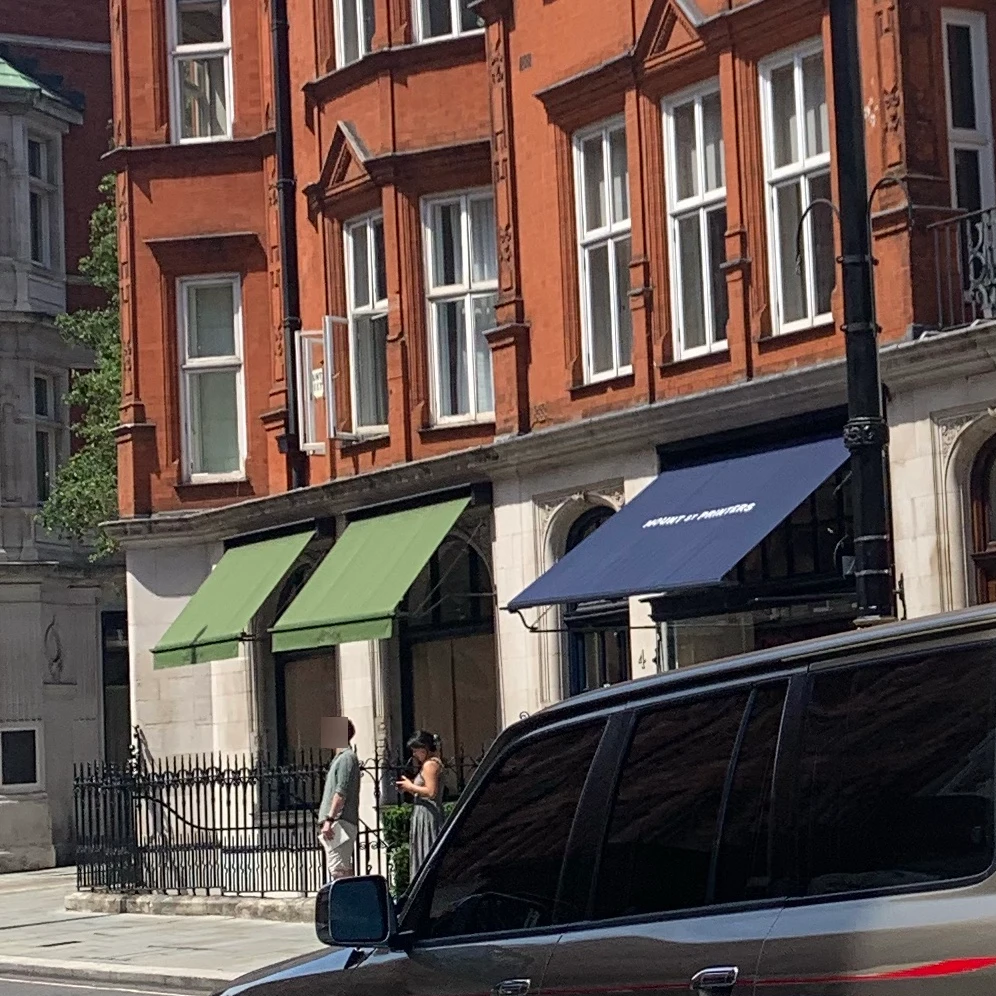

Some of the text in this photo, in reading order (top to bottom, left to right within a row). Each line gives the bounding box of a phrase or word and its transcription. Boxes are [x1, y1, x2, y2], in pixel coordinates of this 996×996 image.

[642, 515, 686, 529] MOUNT
[697, 502, 756, 520] PRINTERS
[638, 649, 647, 669] 4
